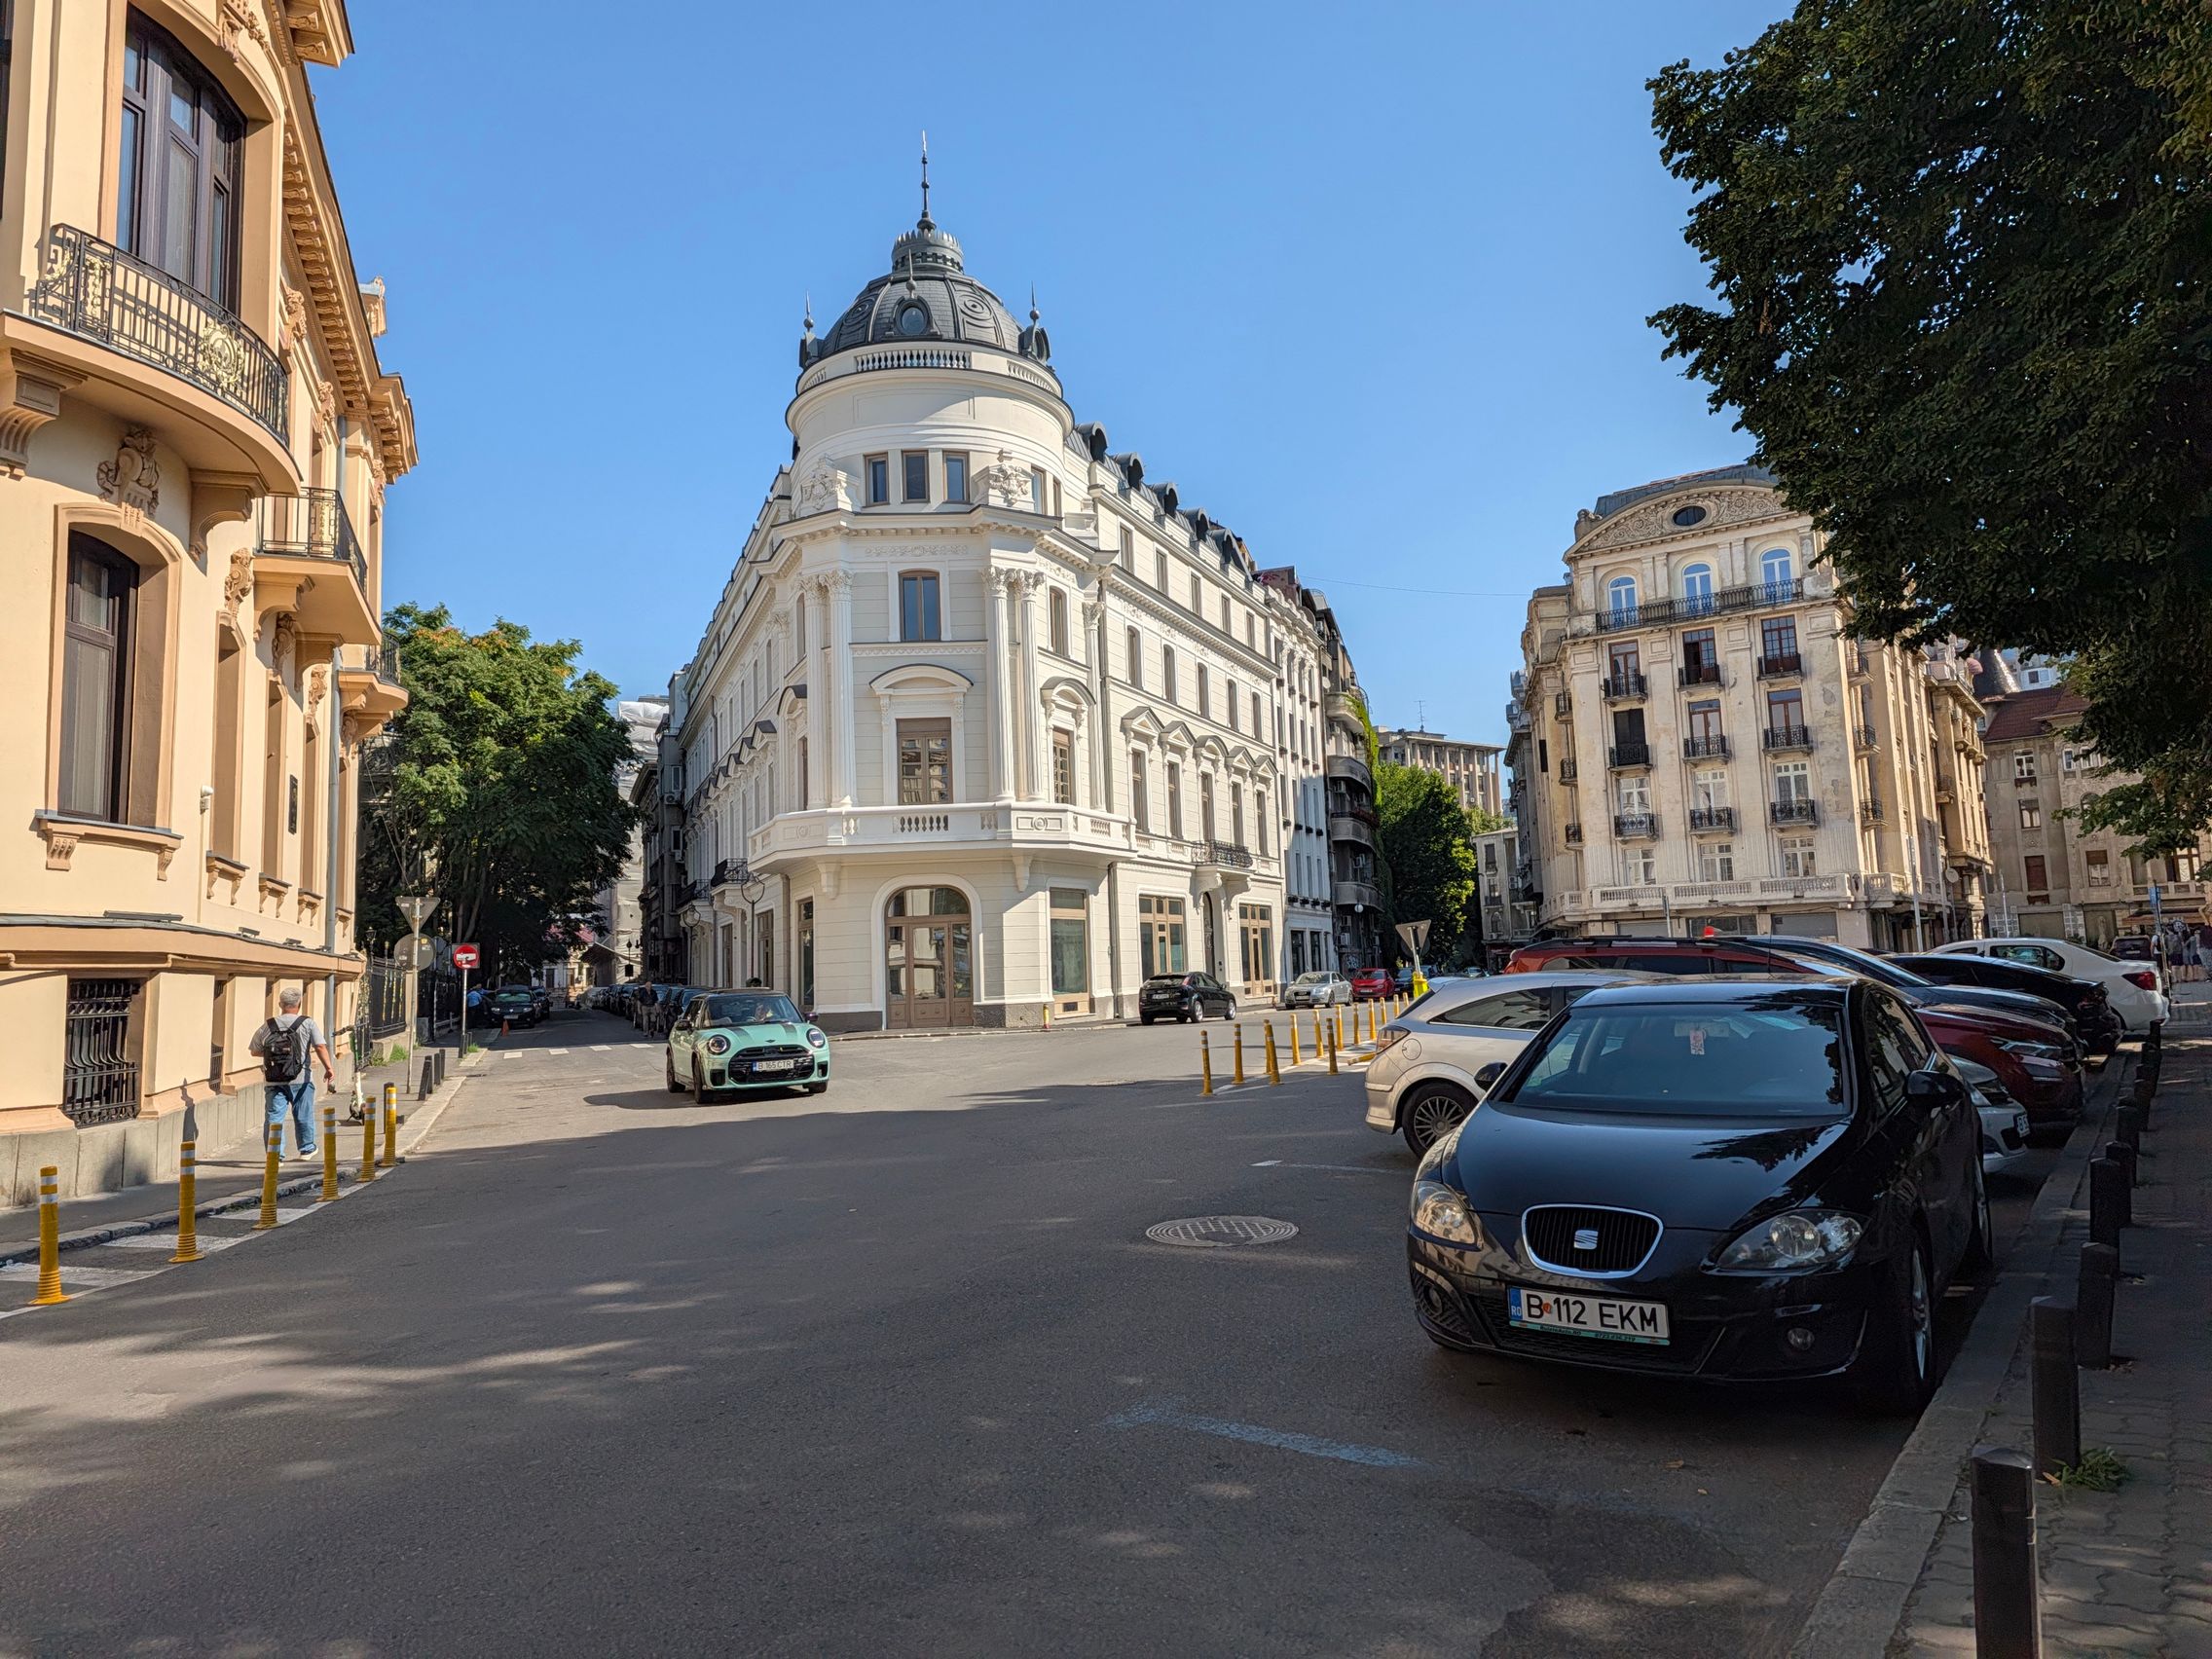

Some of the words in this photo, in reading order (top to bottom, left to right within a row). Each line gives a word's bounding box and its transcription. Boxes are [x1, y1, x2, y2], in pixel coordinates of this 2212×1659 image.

[1511, 1306, 1522, 1316] RO
[1527, 1294, 1544, 1318] B
[1553, 1298, 1587, 1325] 112
[1599, 1303, 1658, 1333] EKM
